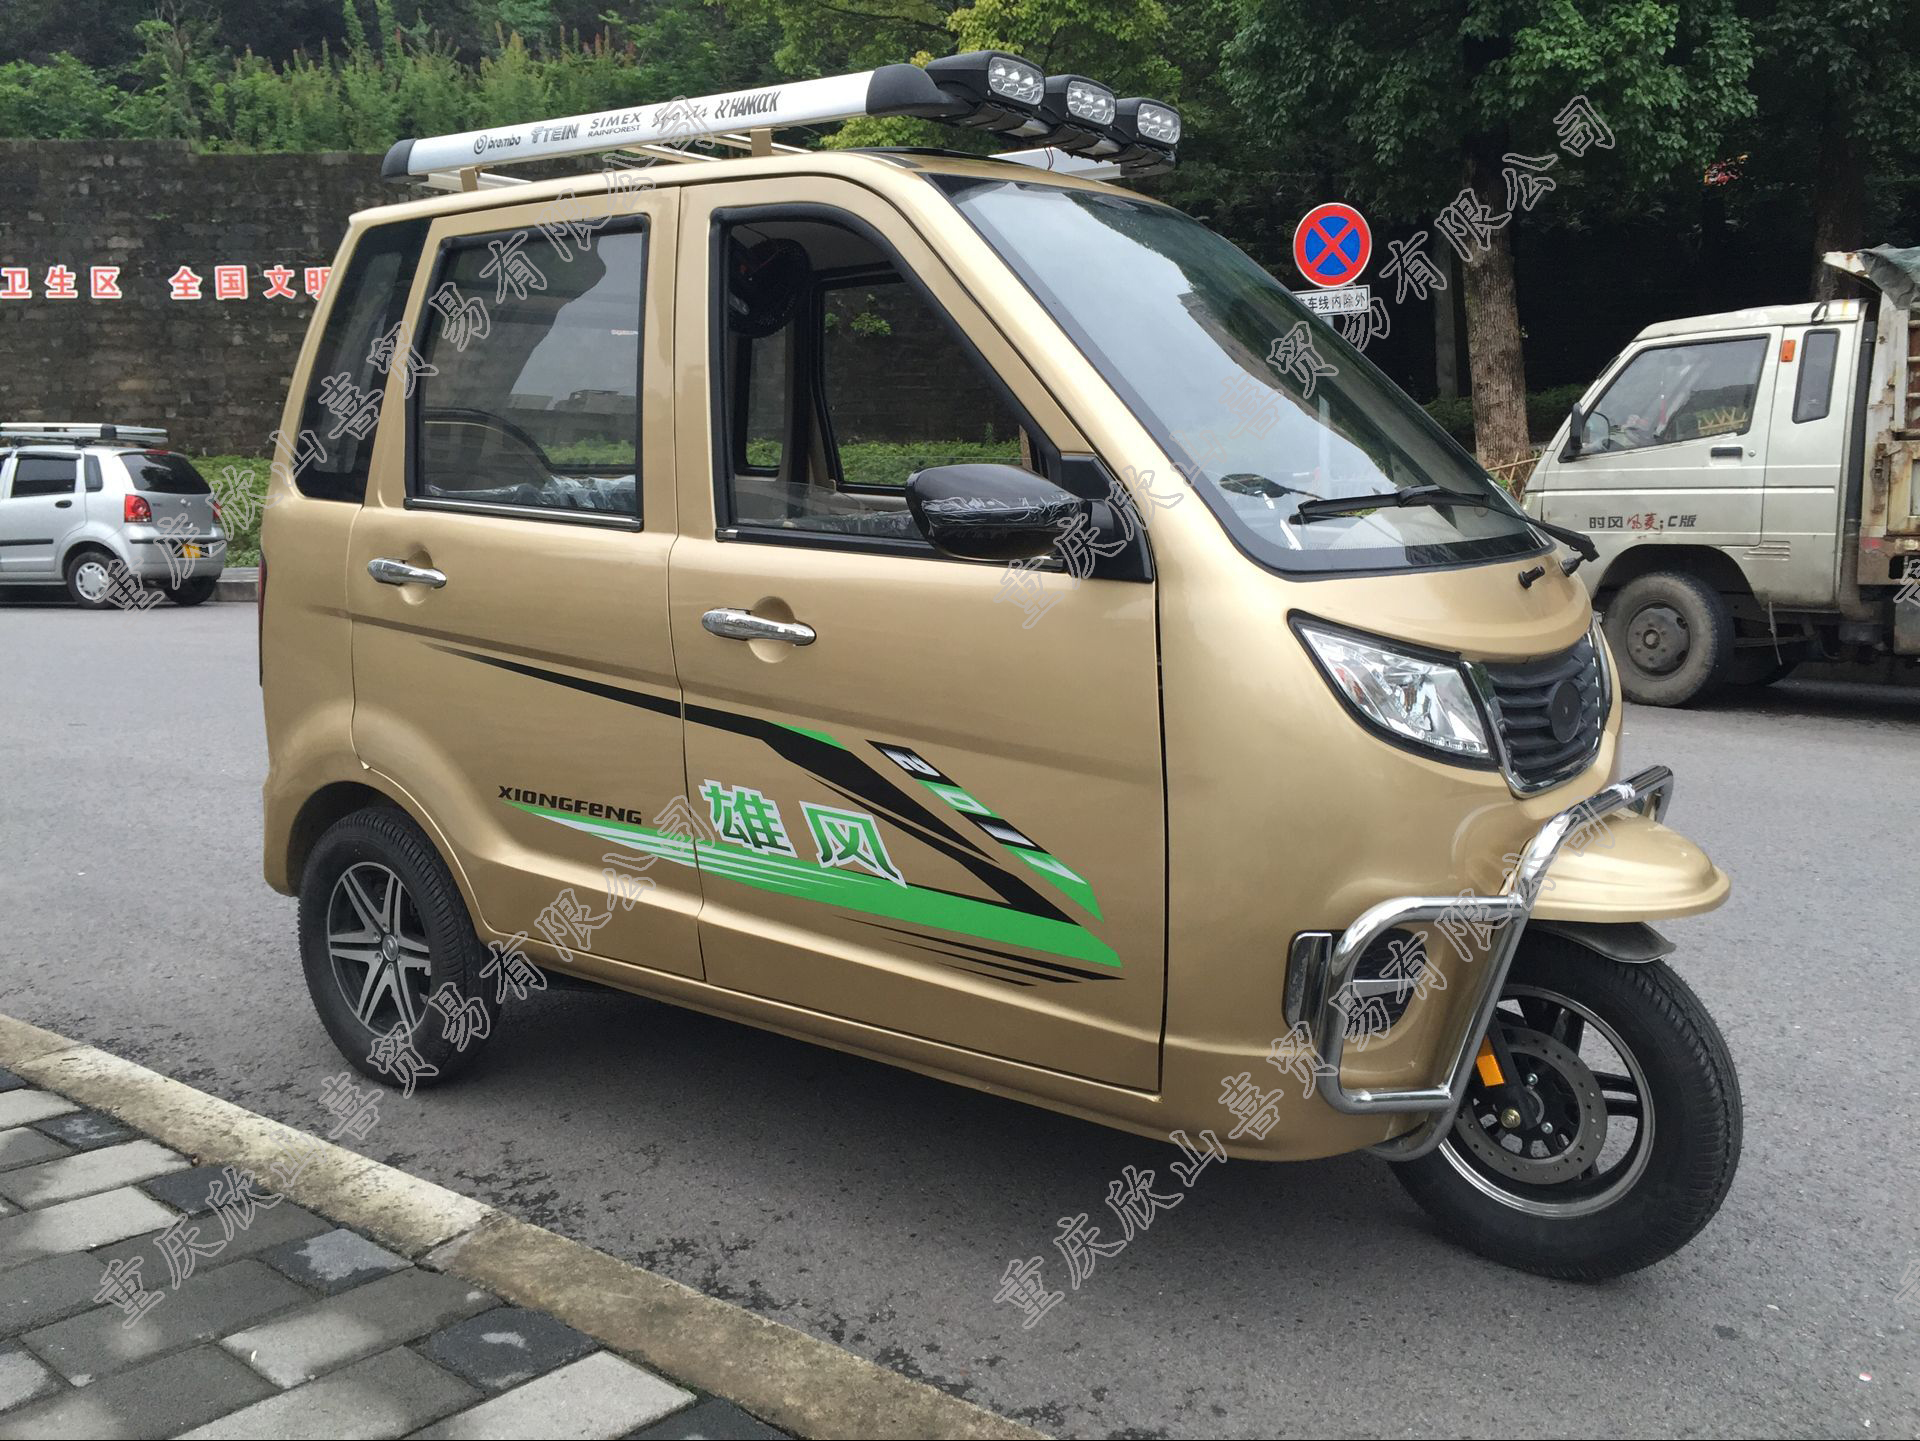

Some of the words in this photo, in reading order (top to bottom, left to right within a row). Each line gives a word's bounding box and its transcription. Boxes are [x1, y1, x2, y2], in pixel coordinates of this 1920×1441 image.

[587, 124, 641, 138] RAINFOREST
[591, 112, 642, 129] SIMEX
[1, 265, 122, 299] 卫生区
[699, 778, 908, 888] 雄风
